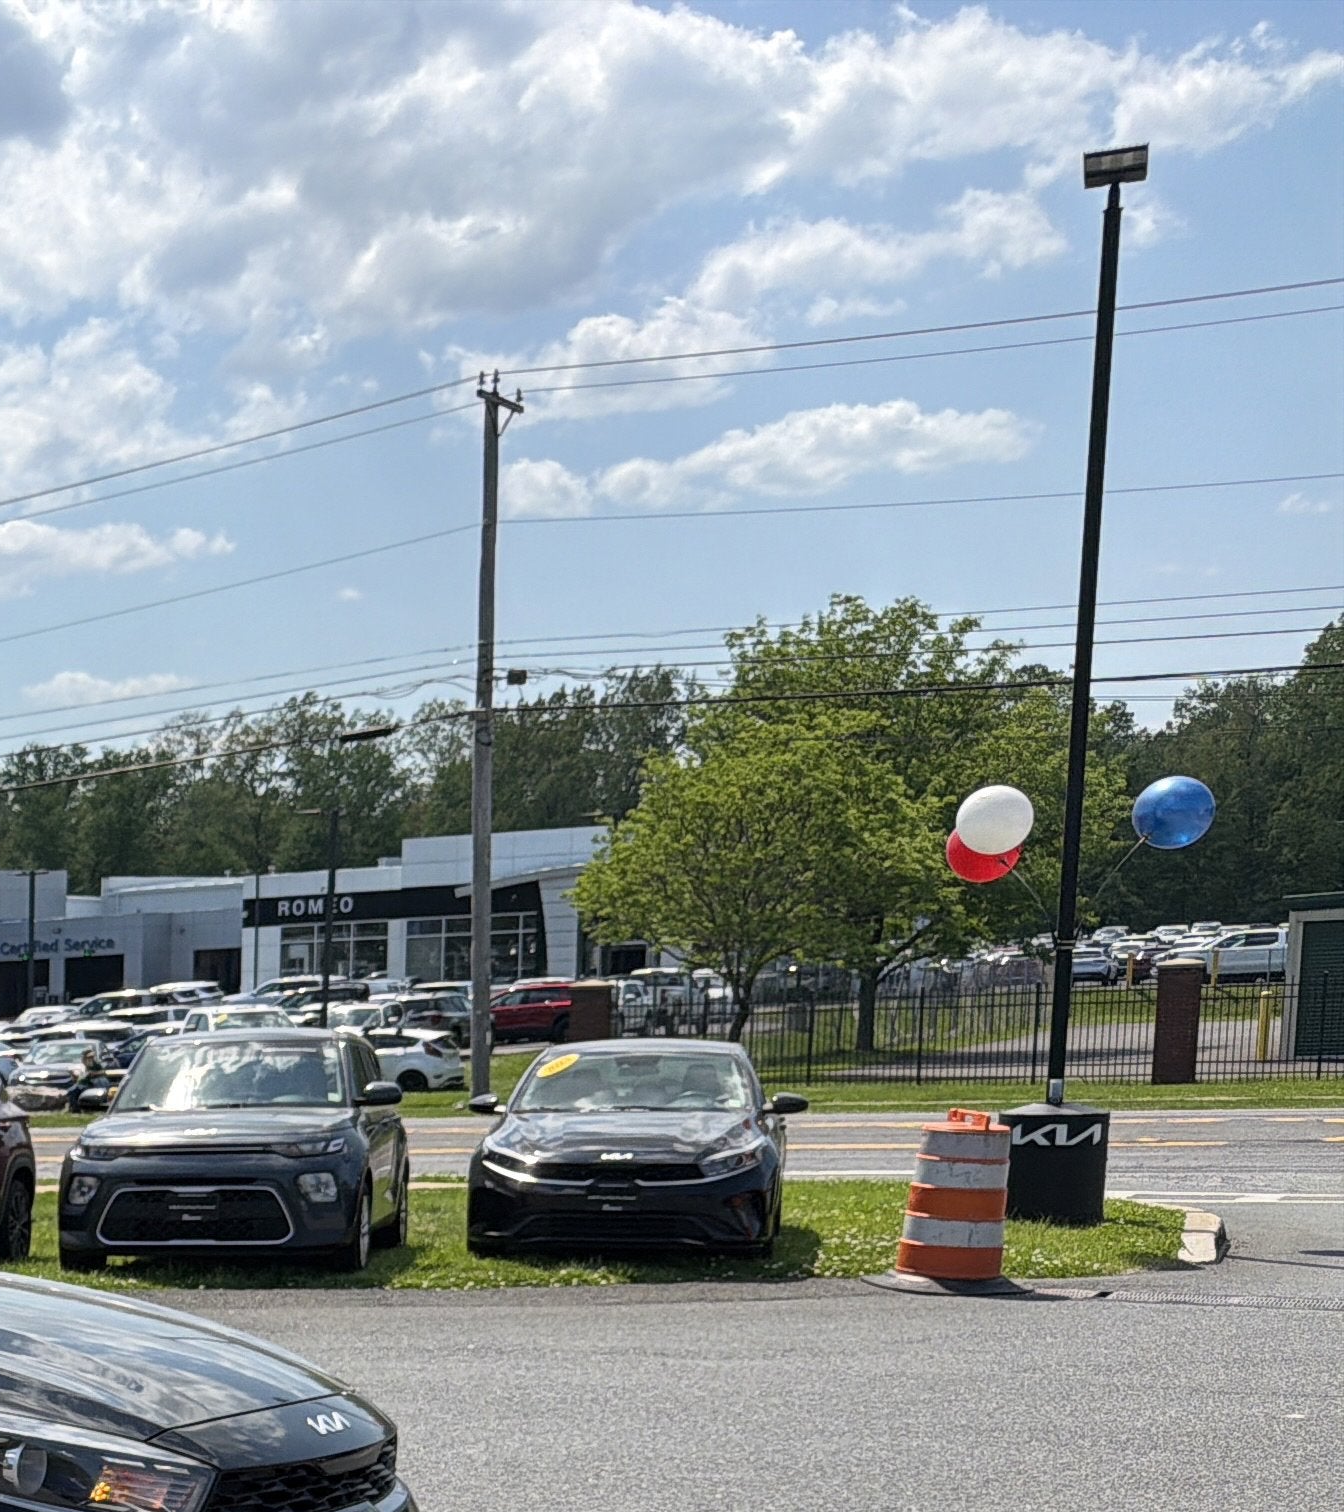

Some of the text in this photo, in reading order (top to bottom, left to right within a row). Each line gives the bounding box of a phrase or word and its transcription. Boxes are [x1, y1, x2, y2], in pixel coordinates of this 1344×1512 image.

[0, 936, 116, 956] Certfied Service
[1011, 1123, 1103, 1147] KIA
[306, 1411, 352, 1435] KIA
